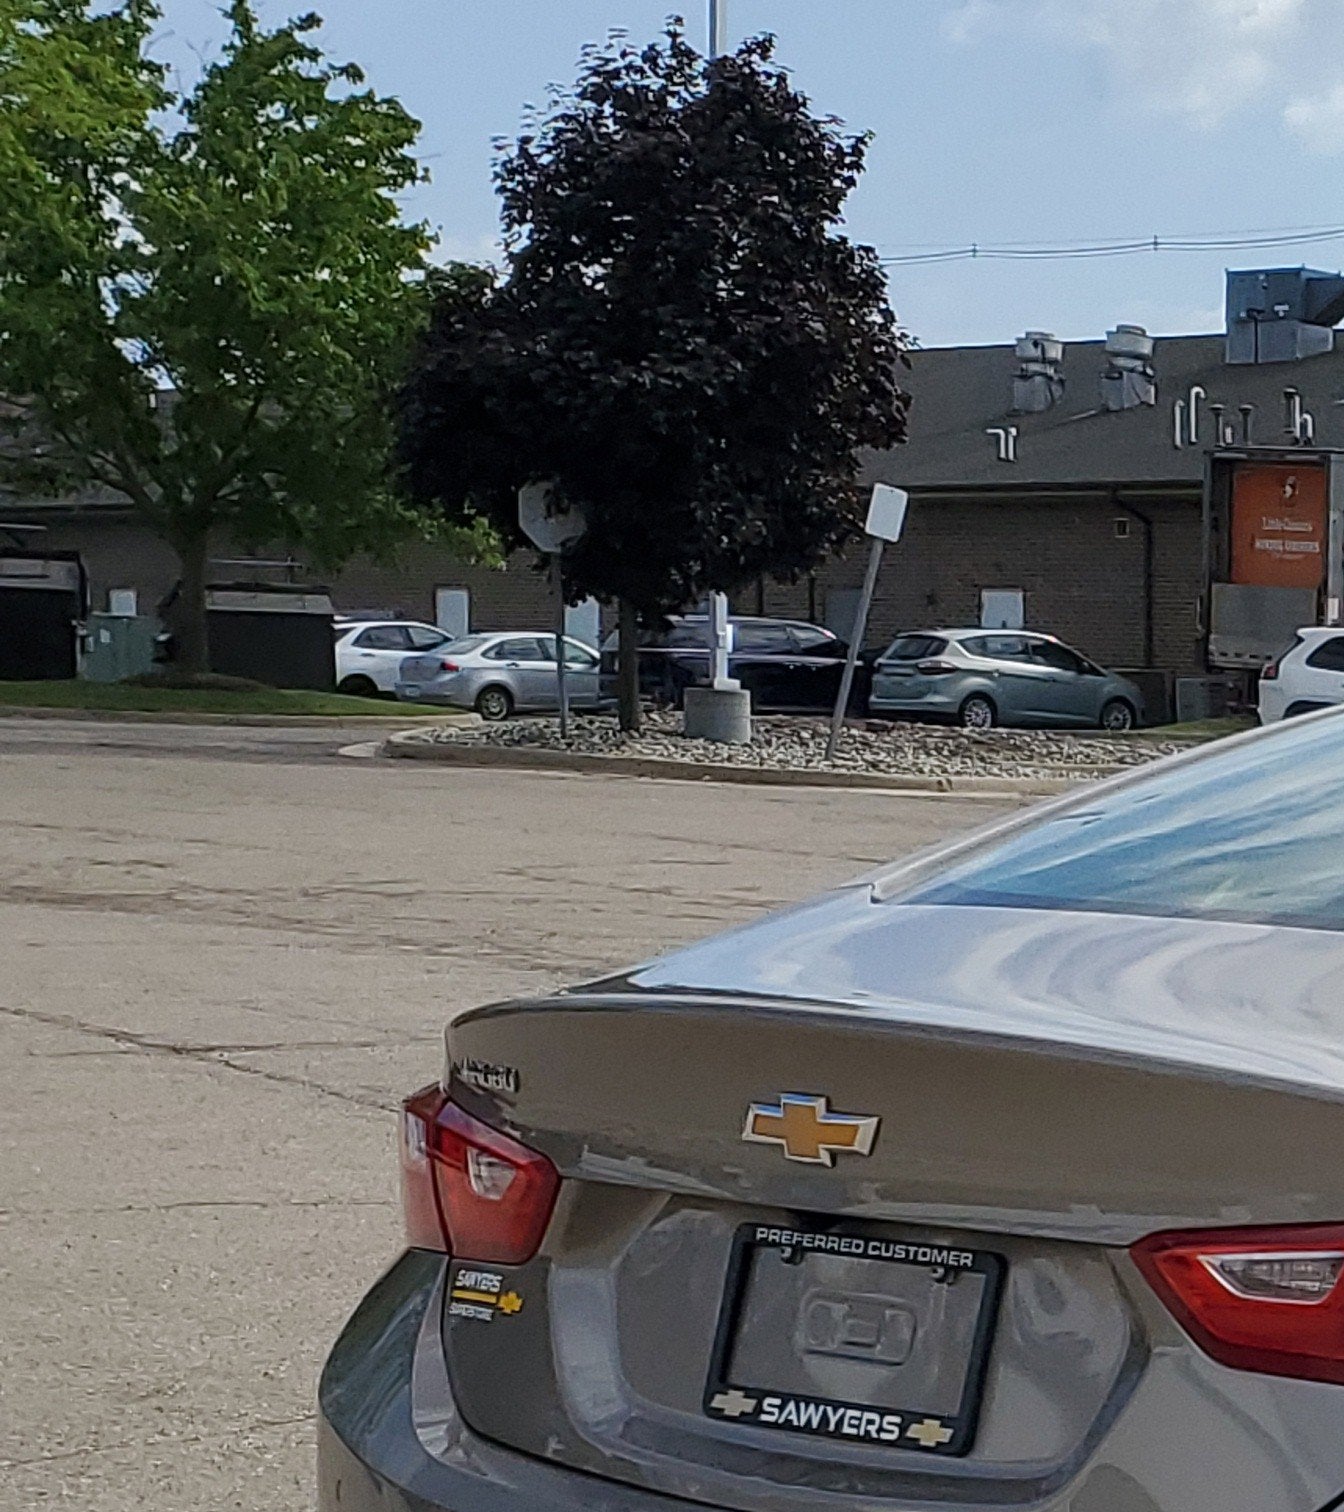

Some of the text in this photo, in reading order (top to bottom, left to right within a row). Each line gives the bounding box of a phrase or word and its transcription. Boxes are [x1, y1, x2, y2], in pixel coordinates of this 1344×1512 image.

[755, 1227, 974, 1268] PREFERRED CUSTOMER
[758, 1396, 903, 1442] SAWYERS
